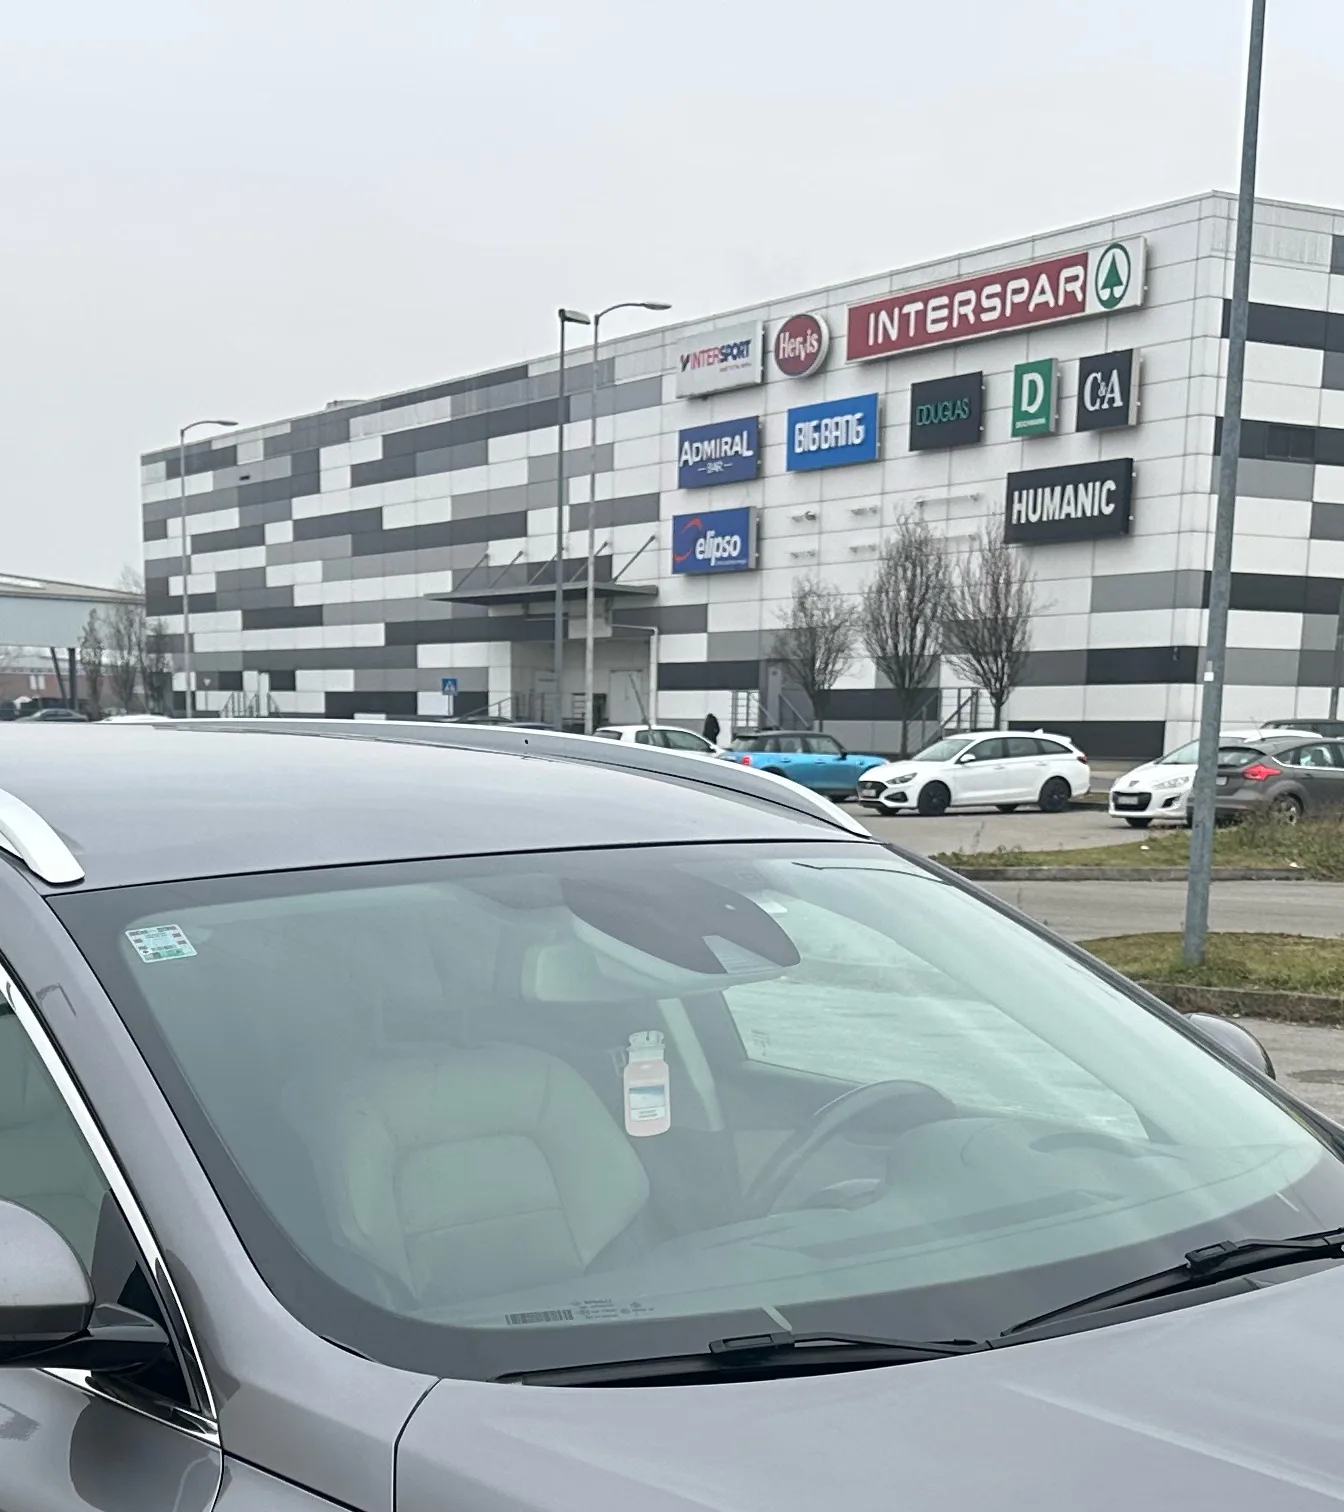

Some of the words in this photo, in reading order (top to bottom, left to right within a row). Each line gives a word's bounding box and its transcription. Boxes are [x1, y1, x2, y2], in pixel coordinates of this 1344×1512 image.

[867, 265, 1085, 346] INTERSPAR
[691, 339, 752, 370] INTERSPORT
[779, 328, 819, 361] Hervis
[1020, 372, 1045, 414] D
[1083, 369, 1124, 411] C&A
[915, 398, 970, 426] DOUGLAS
[678, 430, 754, 468] ADMIRAL
[1011, 480, 1117, 525] HUMANIC
[695, 530, 741, 566] elipso
